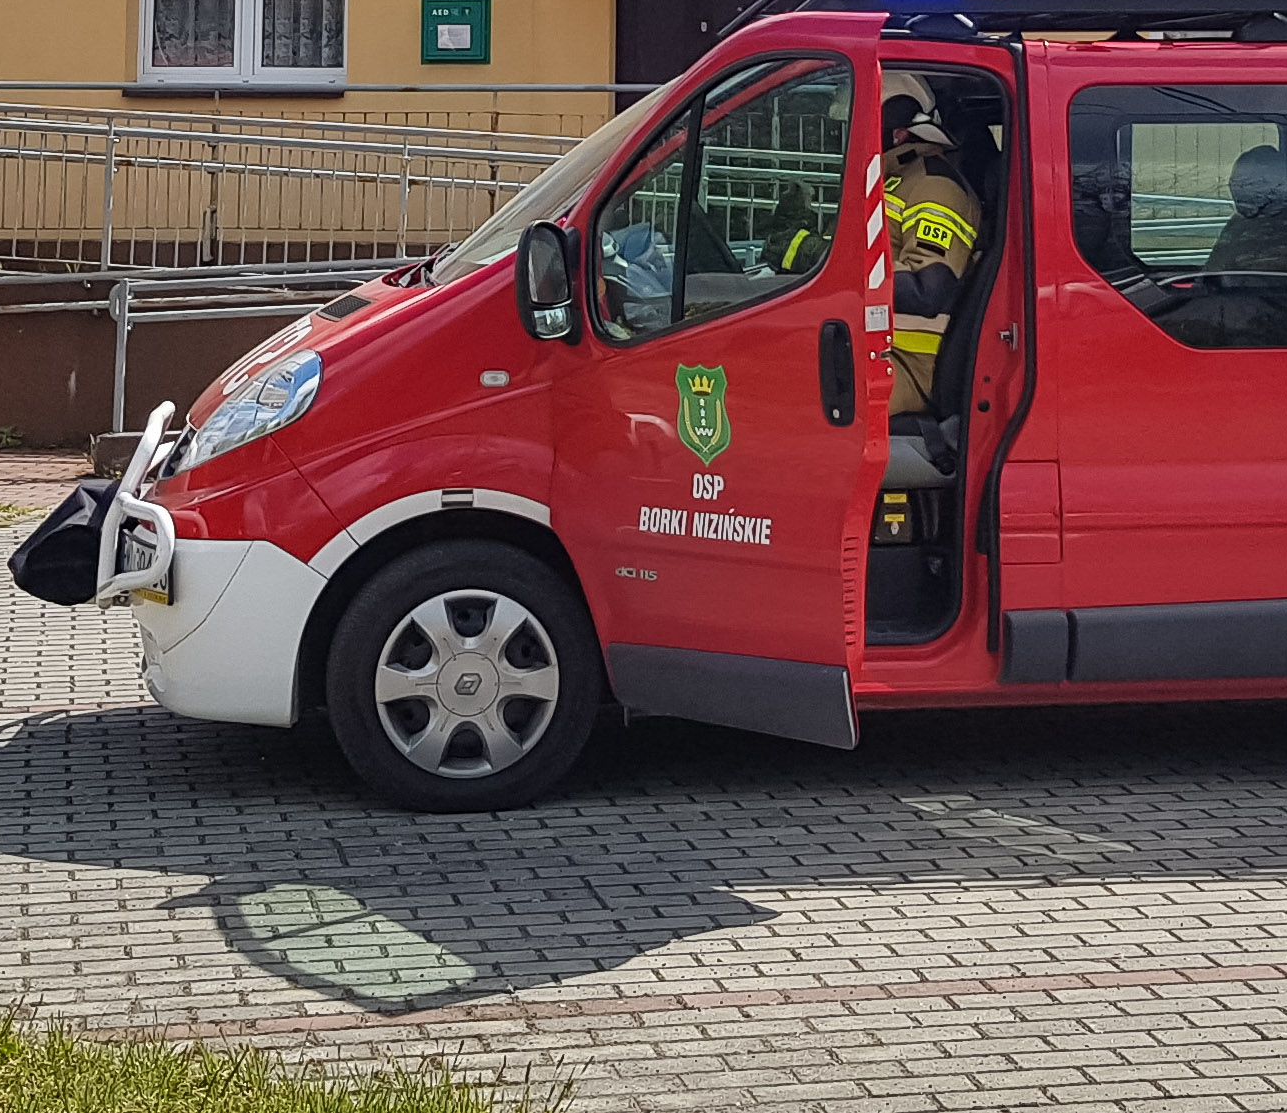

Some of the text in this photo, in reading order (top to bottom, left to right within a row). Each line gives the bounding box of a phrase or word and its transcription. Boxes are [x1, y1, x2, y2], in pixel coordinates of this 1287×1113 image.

[923, 225, 947, 241] OSP
[692, 473, 724, 500] OSP
[639, 506, 772, 545] BORKI NIZIŃSKIE
